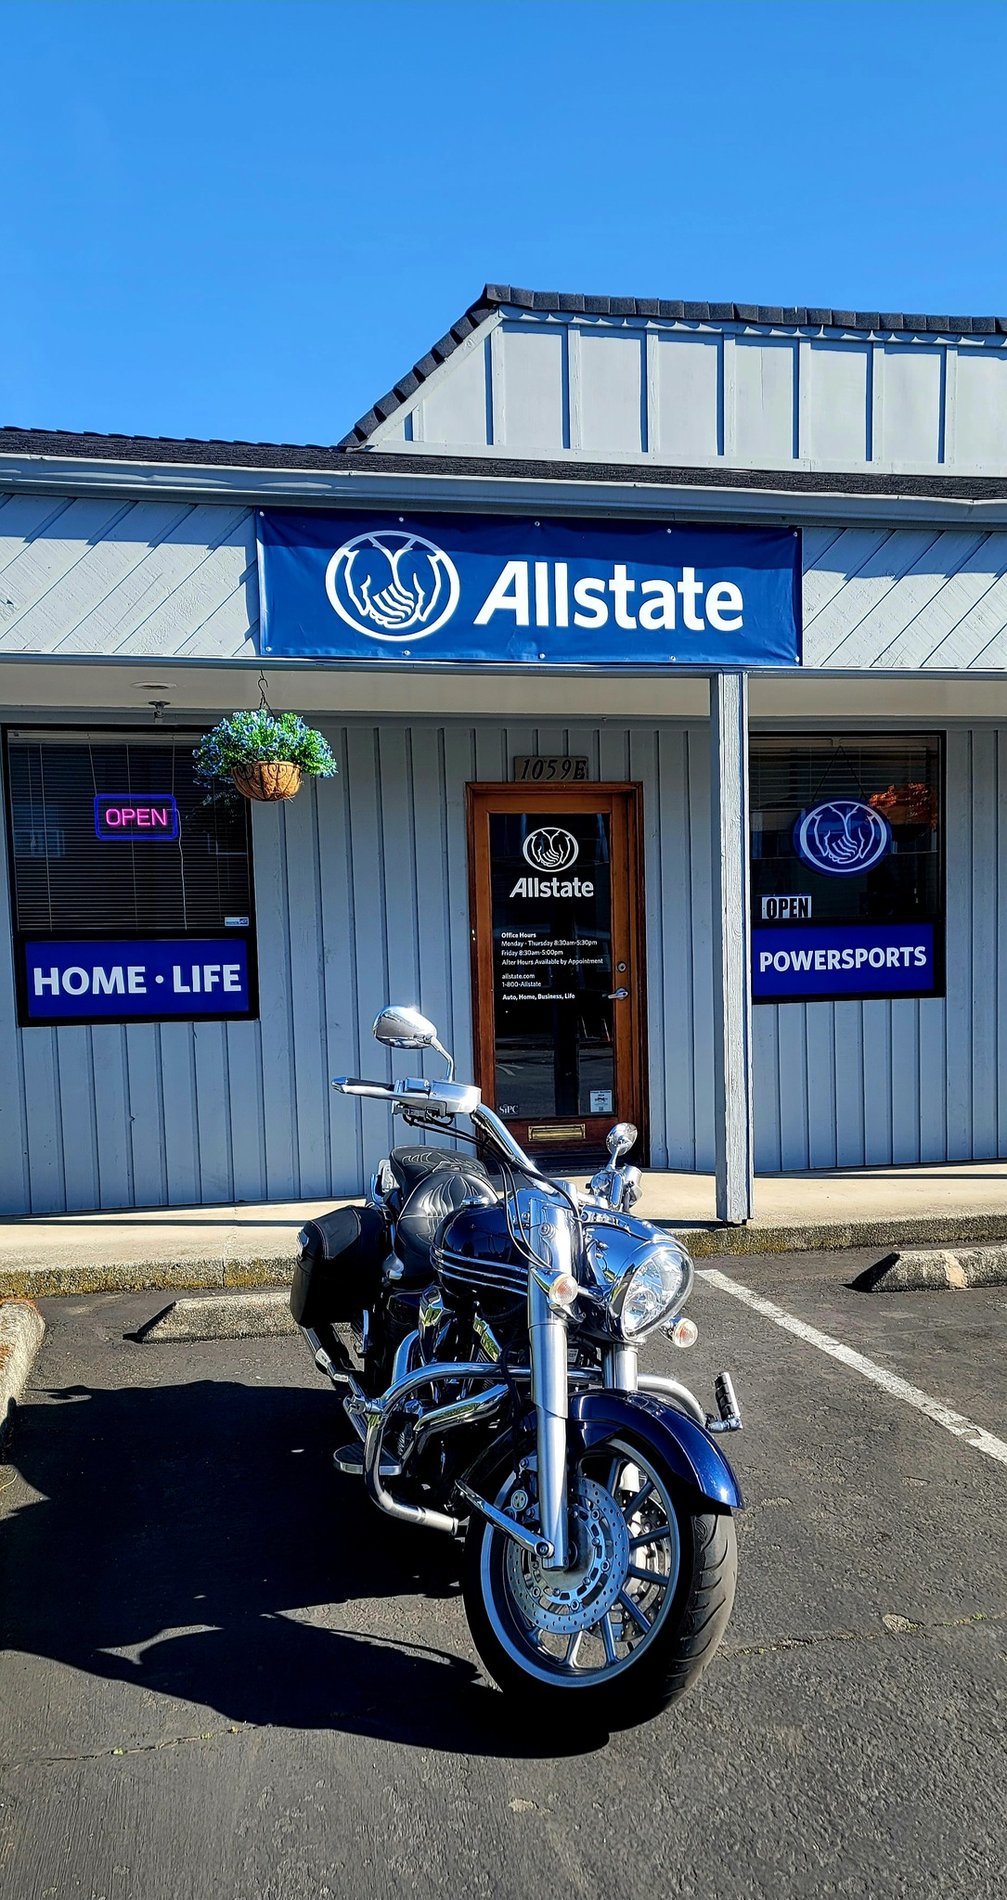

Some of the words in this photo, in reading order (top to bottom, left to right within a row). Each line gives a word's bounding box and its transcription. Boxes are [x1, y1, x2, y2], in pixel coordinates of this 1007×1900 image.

[473, 561, 744, 632] Allstate
[520, 758, 587, 780] 1059E
[105, 808, 167, 826] OPEN
[509, 877, 595, 898] Allstate
[766, 897, 809, 919] OPEN
[528, 940, 553, 948] Thursday
[560, 958, 566, 966] by
[568, 958, 604, 966] Appointment
[759, 946, 927, 973] POWERSPORTS
[33, 966, 147, 996] HOME
[172, 964, 242, 993] LIFE
